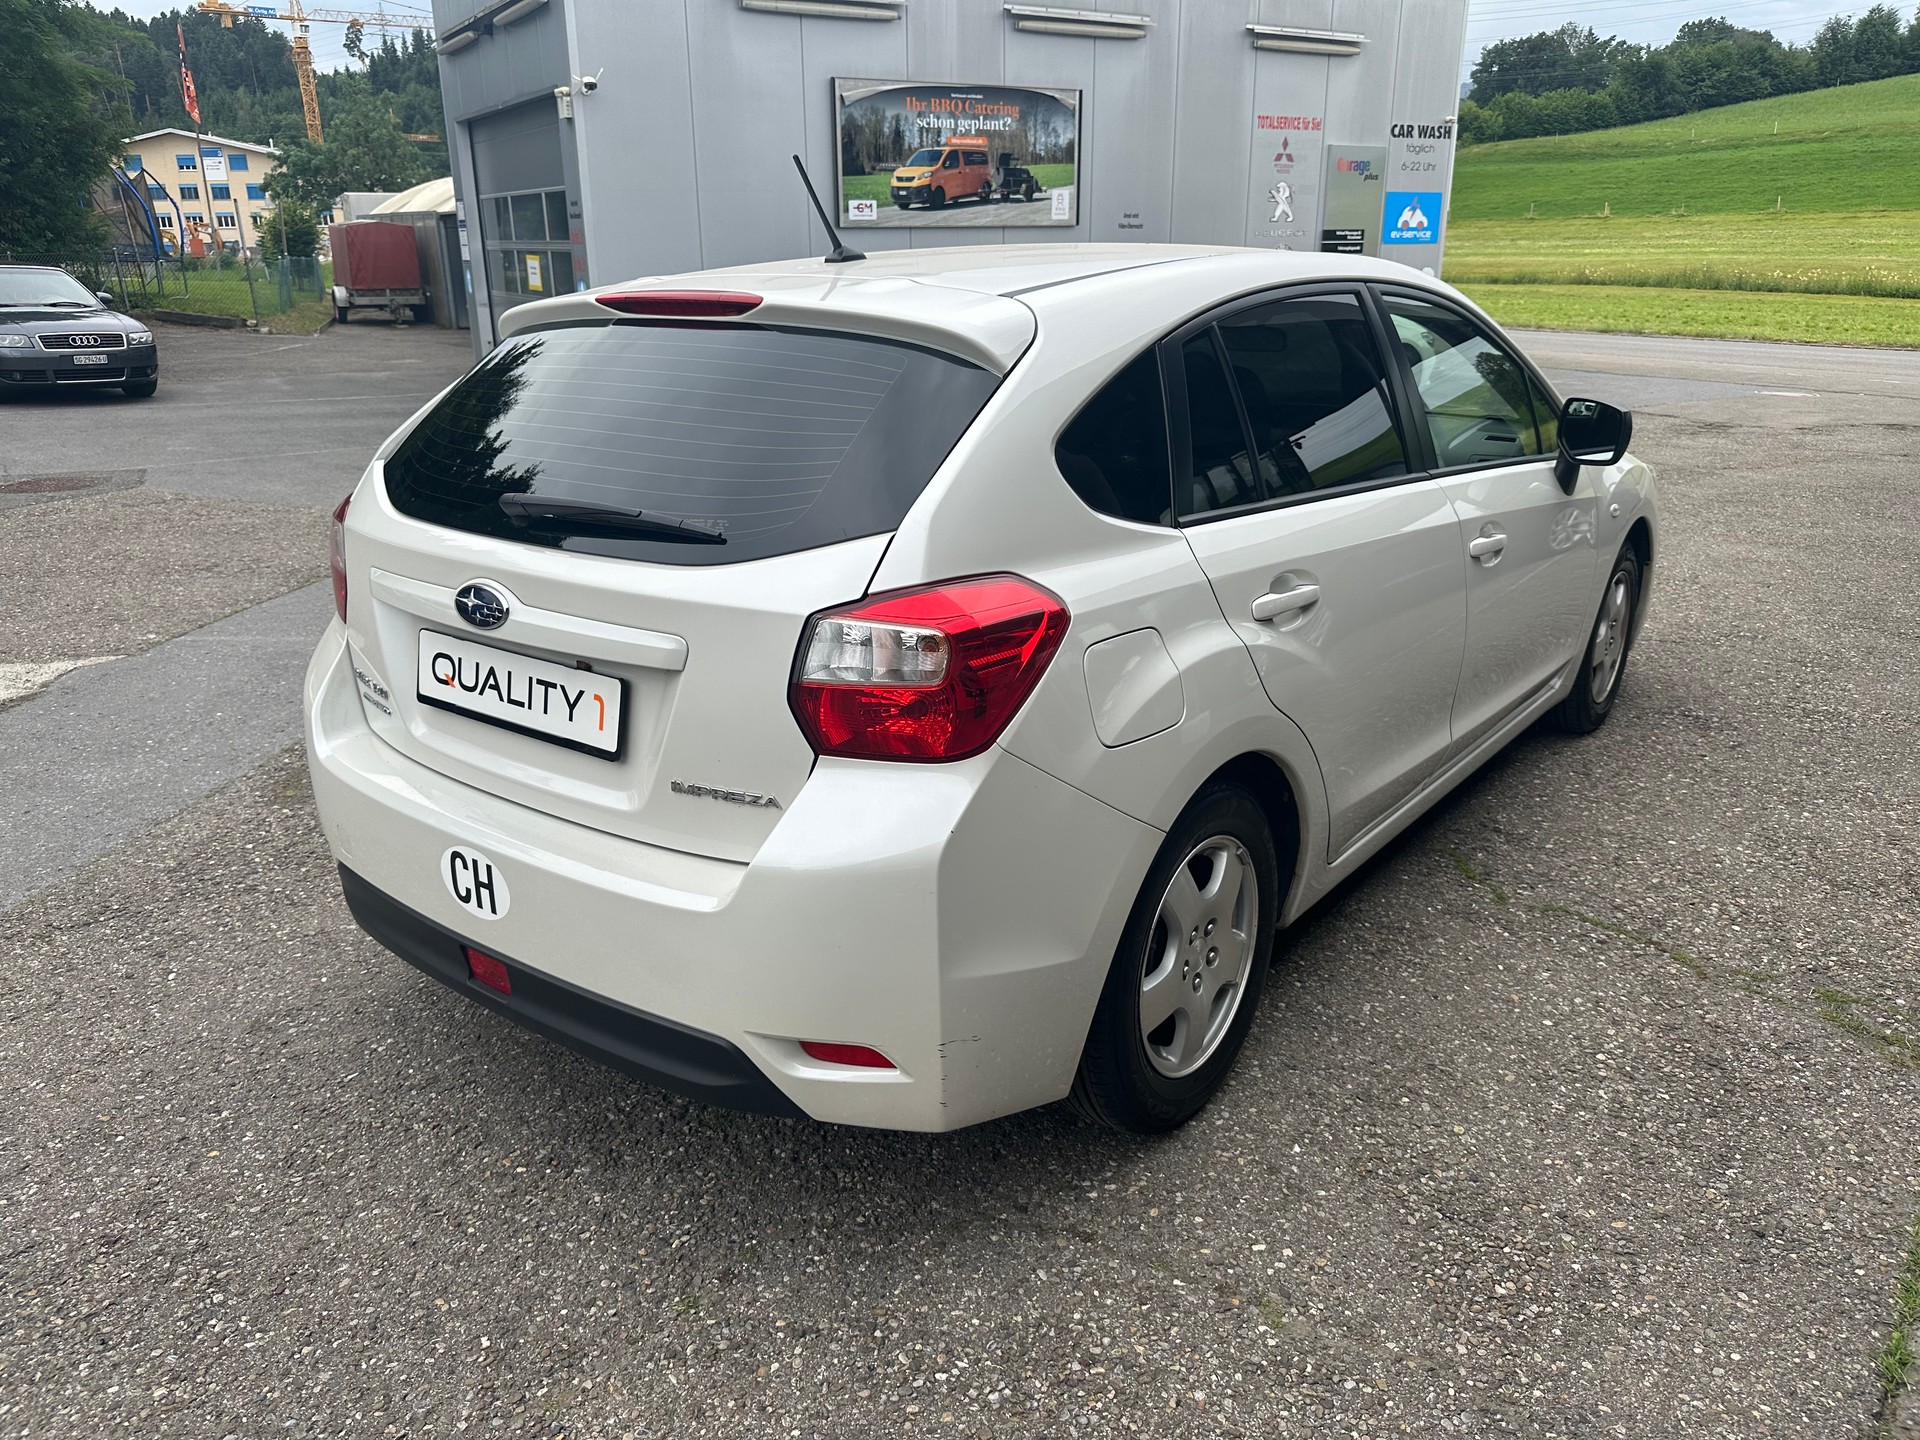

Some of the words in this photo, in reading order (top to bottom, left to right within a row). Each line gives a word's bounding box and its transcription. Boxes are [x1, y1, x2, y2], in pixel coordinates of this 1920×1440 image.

[905, 97, 927, 112] Ihr
[930, 98, 962, 117] BBQ
[964, 99, 1020, 120] Catering
[916, 113, 955, 129] schon
[956, 115, 1012, 135] geplant?
[1257, 115, 1301, 130] TOTALSERVICE
[1390, 123, 1415, 139] CAR
[1417, 124, 1452, 140] WASH
[1405, 143, 1435, 156] täglich
[1400, 161, 1421, 172] 6-22
[1422, 161, 1437, 172] Uhr
[1363, 171, 1379, 182] plus
[1390, 230, 1432, 239] ev-service
[431, 651, 586, 723] QUALITY
[670, 778, 783, 810] IMPREZA
[449, 849, 498, 916] CH
